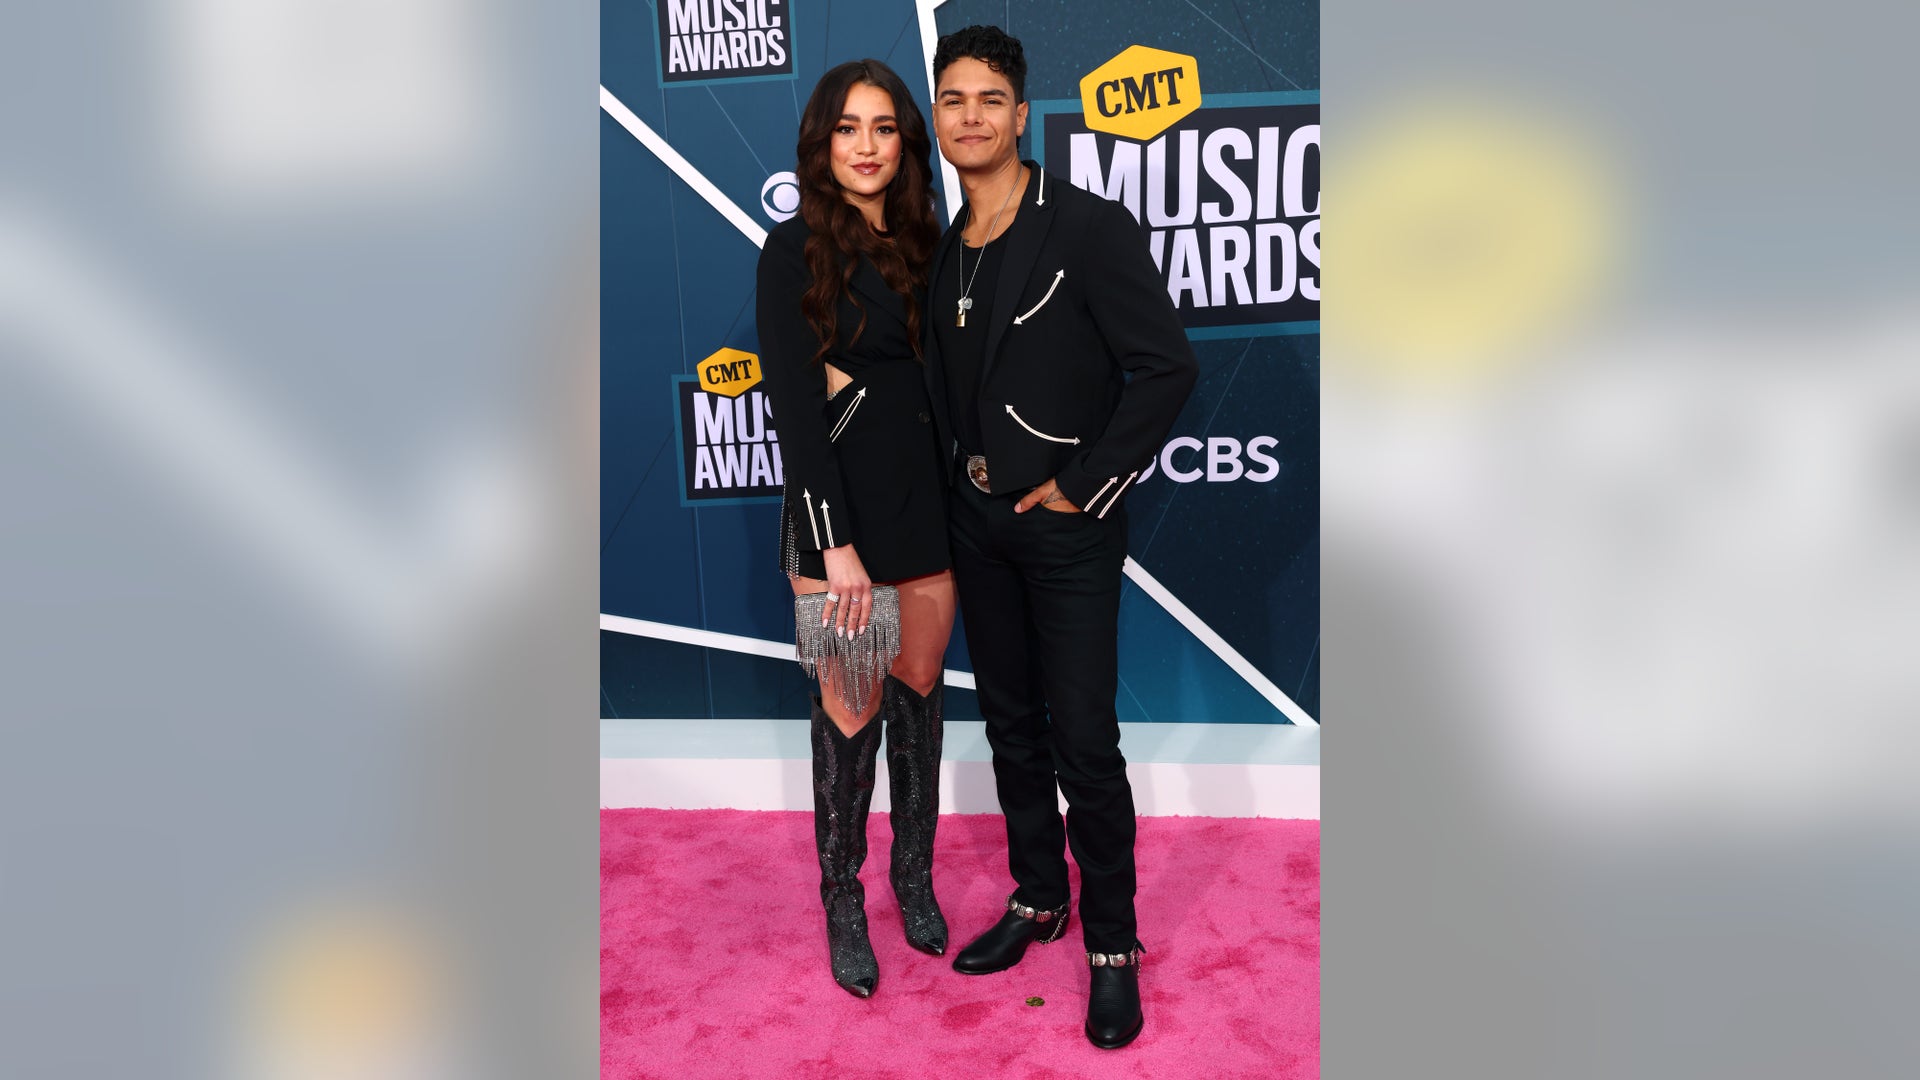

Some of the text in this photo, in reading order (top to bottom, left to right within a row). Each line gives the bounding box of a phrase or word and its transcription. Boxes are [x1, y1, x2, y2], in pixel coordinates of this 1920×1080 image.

[667, 0, 781, 35] MUSIC
[668, 28, 786, 73] AWARDS
[1095, 66, 1184, 118] CMT
[1070, 124, 1320, 228] MUSIC
[1150, 219, 1320, 309] ARDS
[705, 359, 752, 385] CMT
[1160, 435, 1280, 483] CBS
